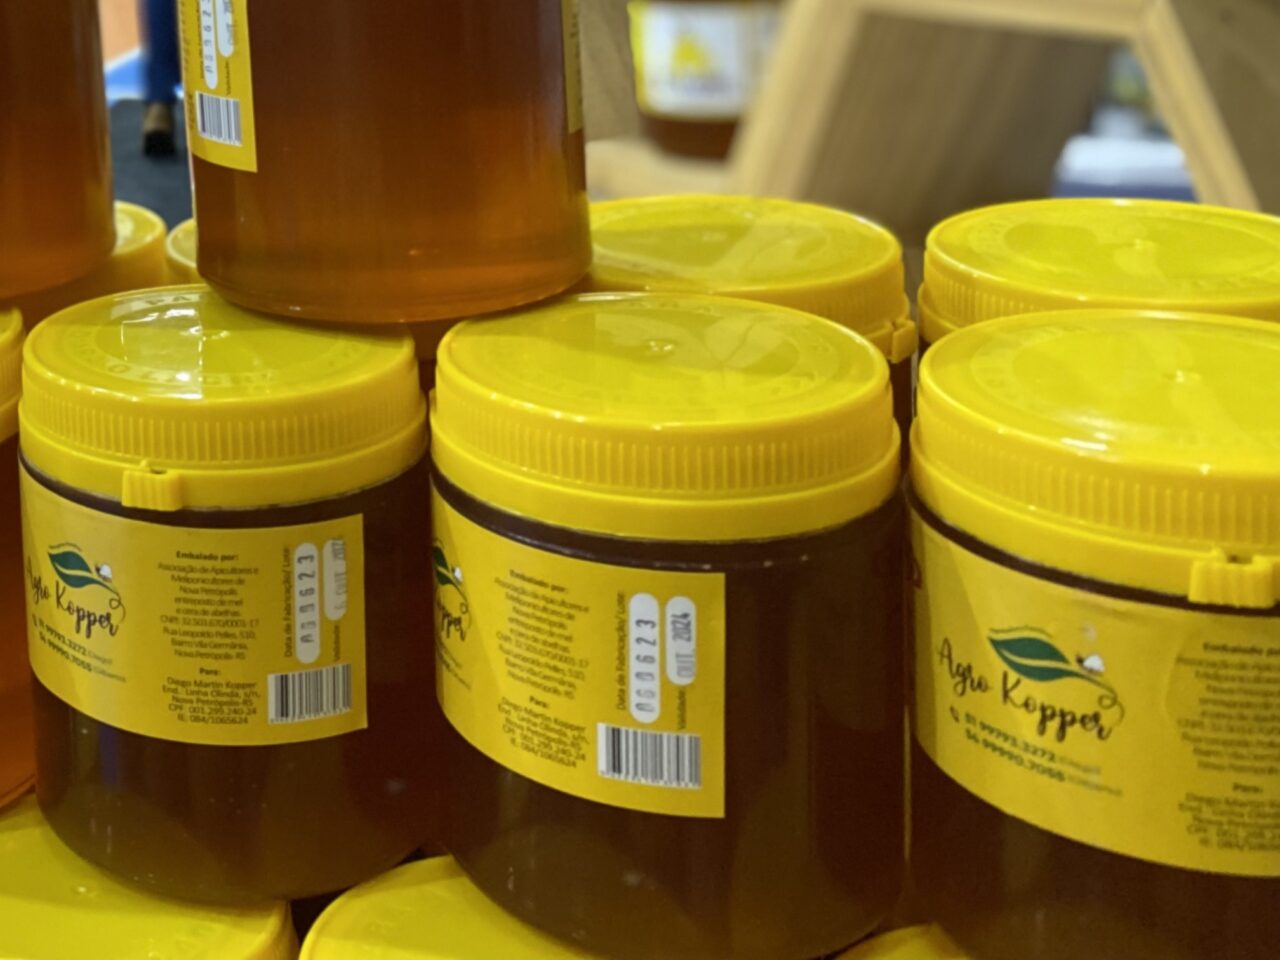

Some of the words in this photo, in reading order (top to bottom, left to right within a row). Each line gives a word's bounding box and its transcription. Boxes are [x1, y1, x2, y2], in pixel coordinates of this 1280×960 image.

[55, 579, 120, 640] Kopper
[937, 637, 990, 697] Agro
[1001, 670, 1113, 742] Kopper
